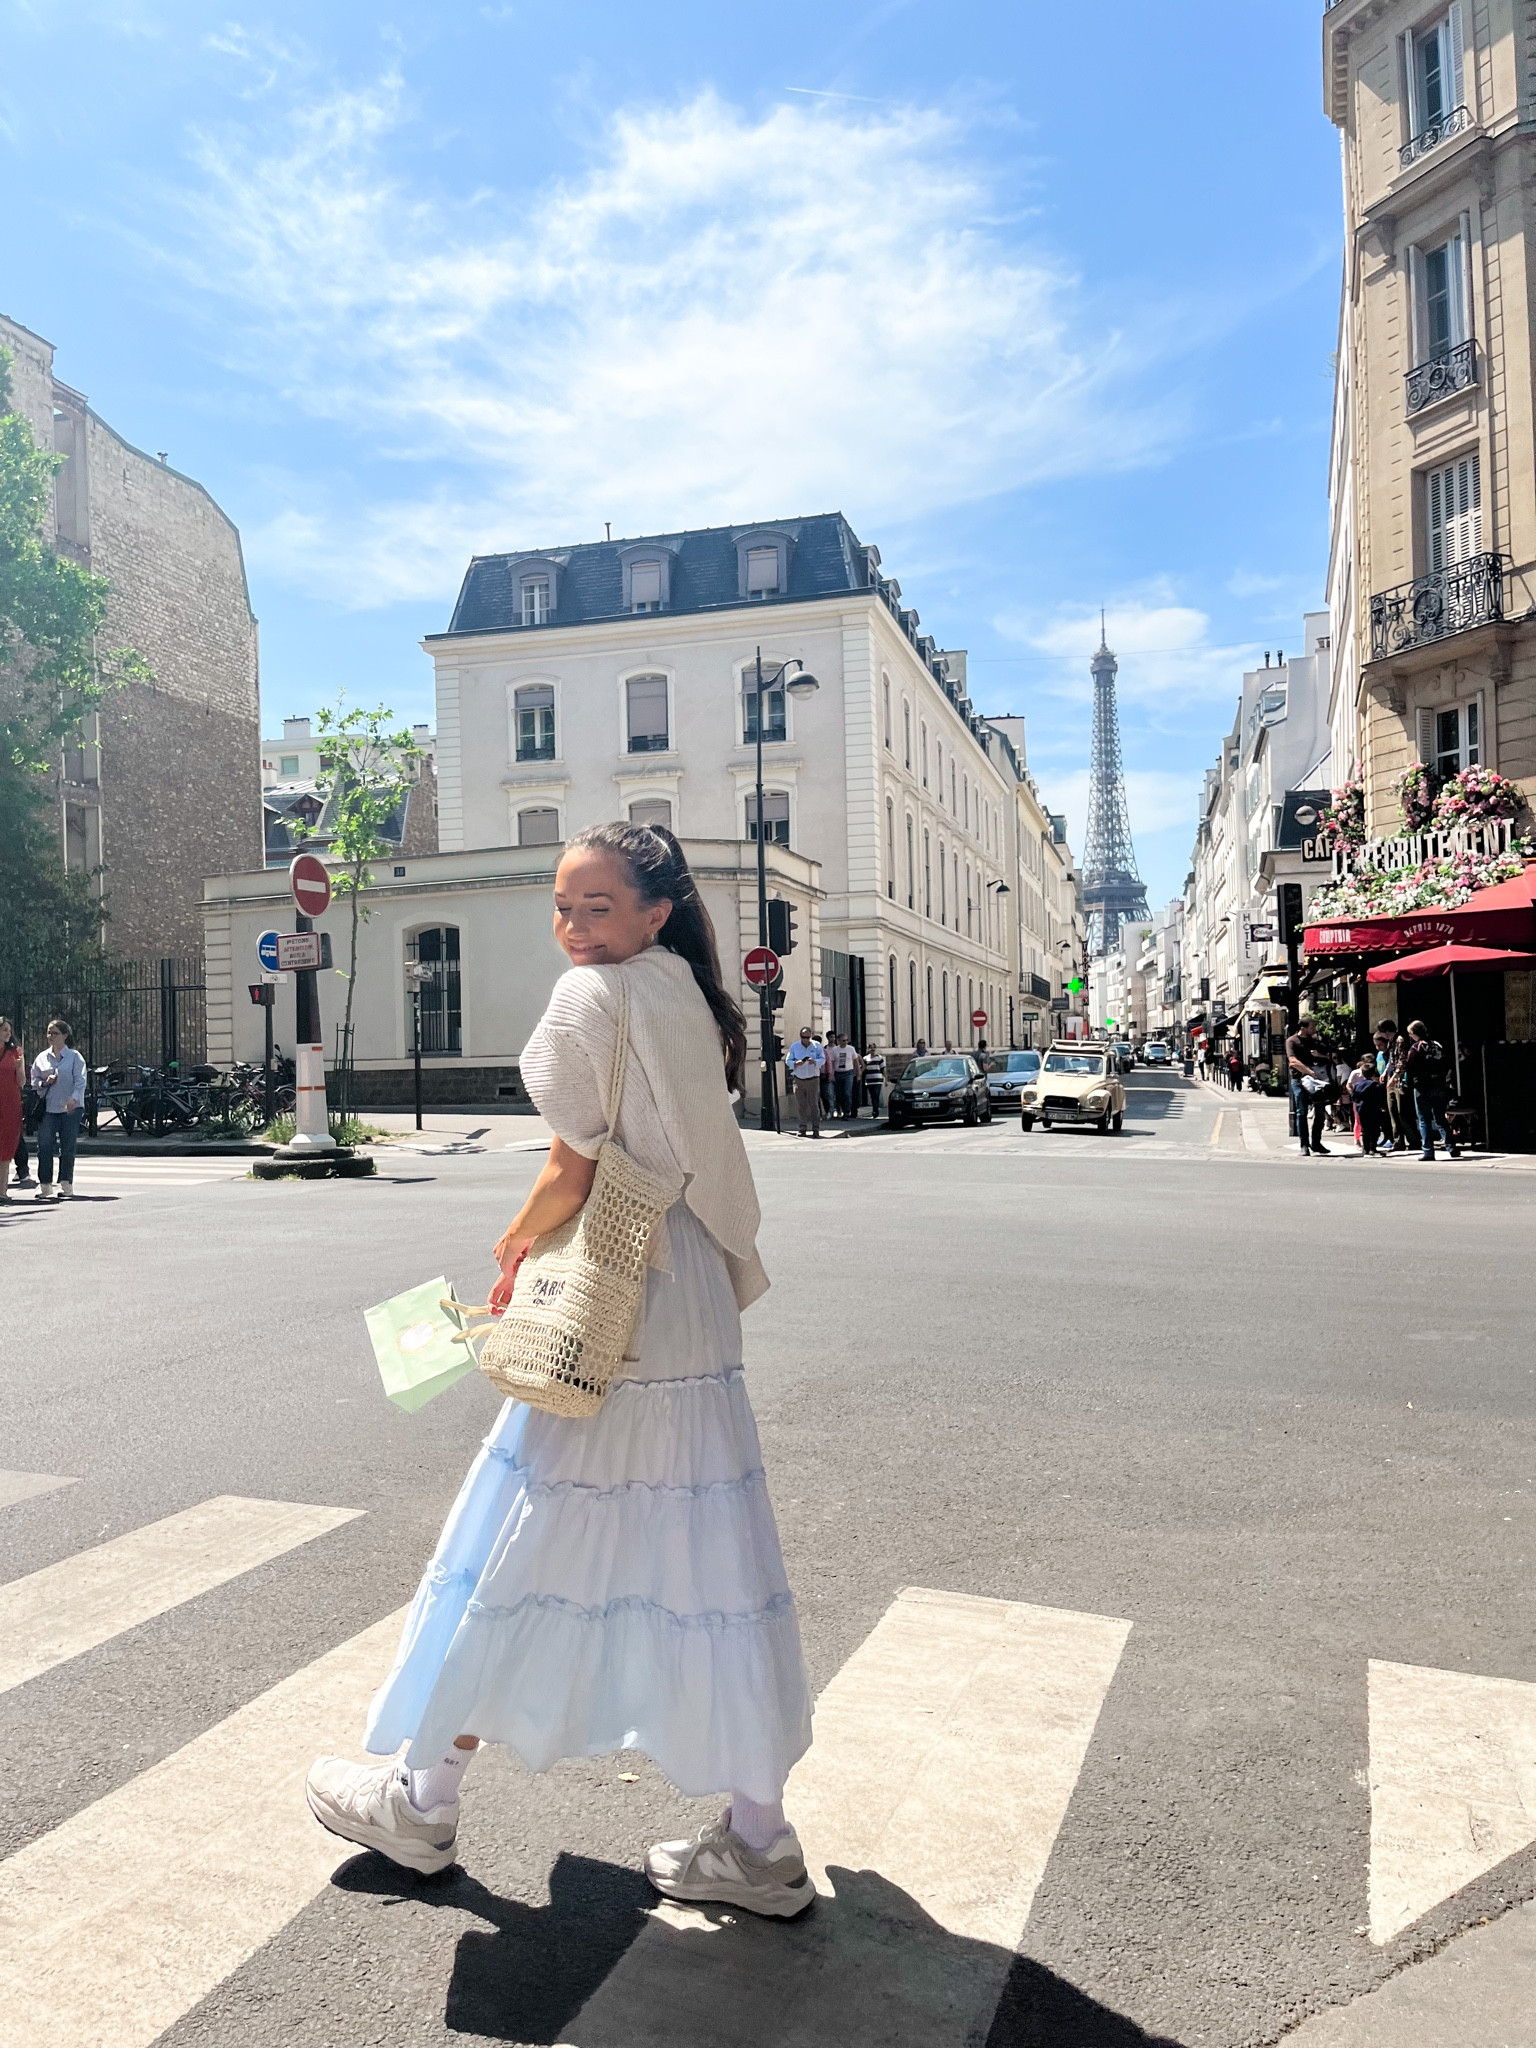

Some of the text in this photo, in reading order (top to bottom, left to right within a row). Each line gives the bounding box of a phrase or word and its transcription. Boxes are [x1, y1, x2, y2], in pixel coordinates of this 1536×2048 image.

[1304, 837, 1334, 860] CAF
[1243, 913, 1251, 959] HOTEL
[1403, 922, 1432, 938] DEPUIS
[531, 1277, 566, 1297] PARIS
